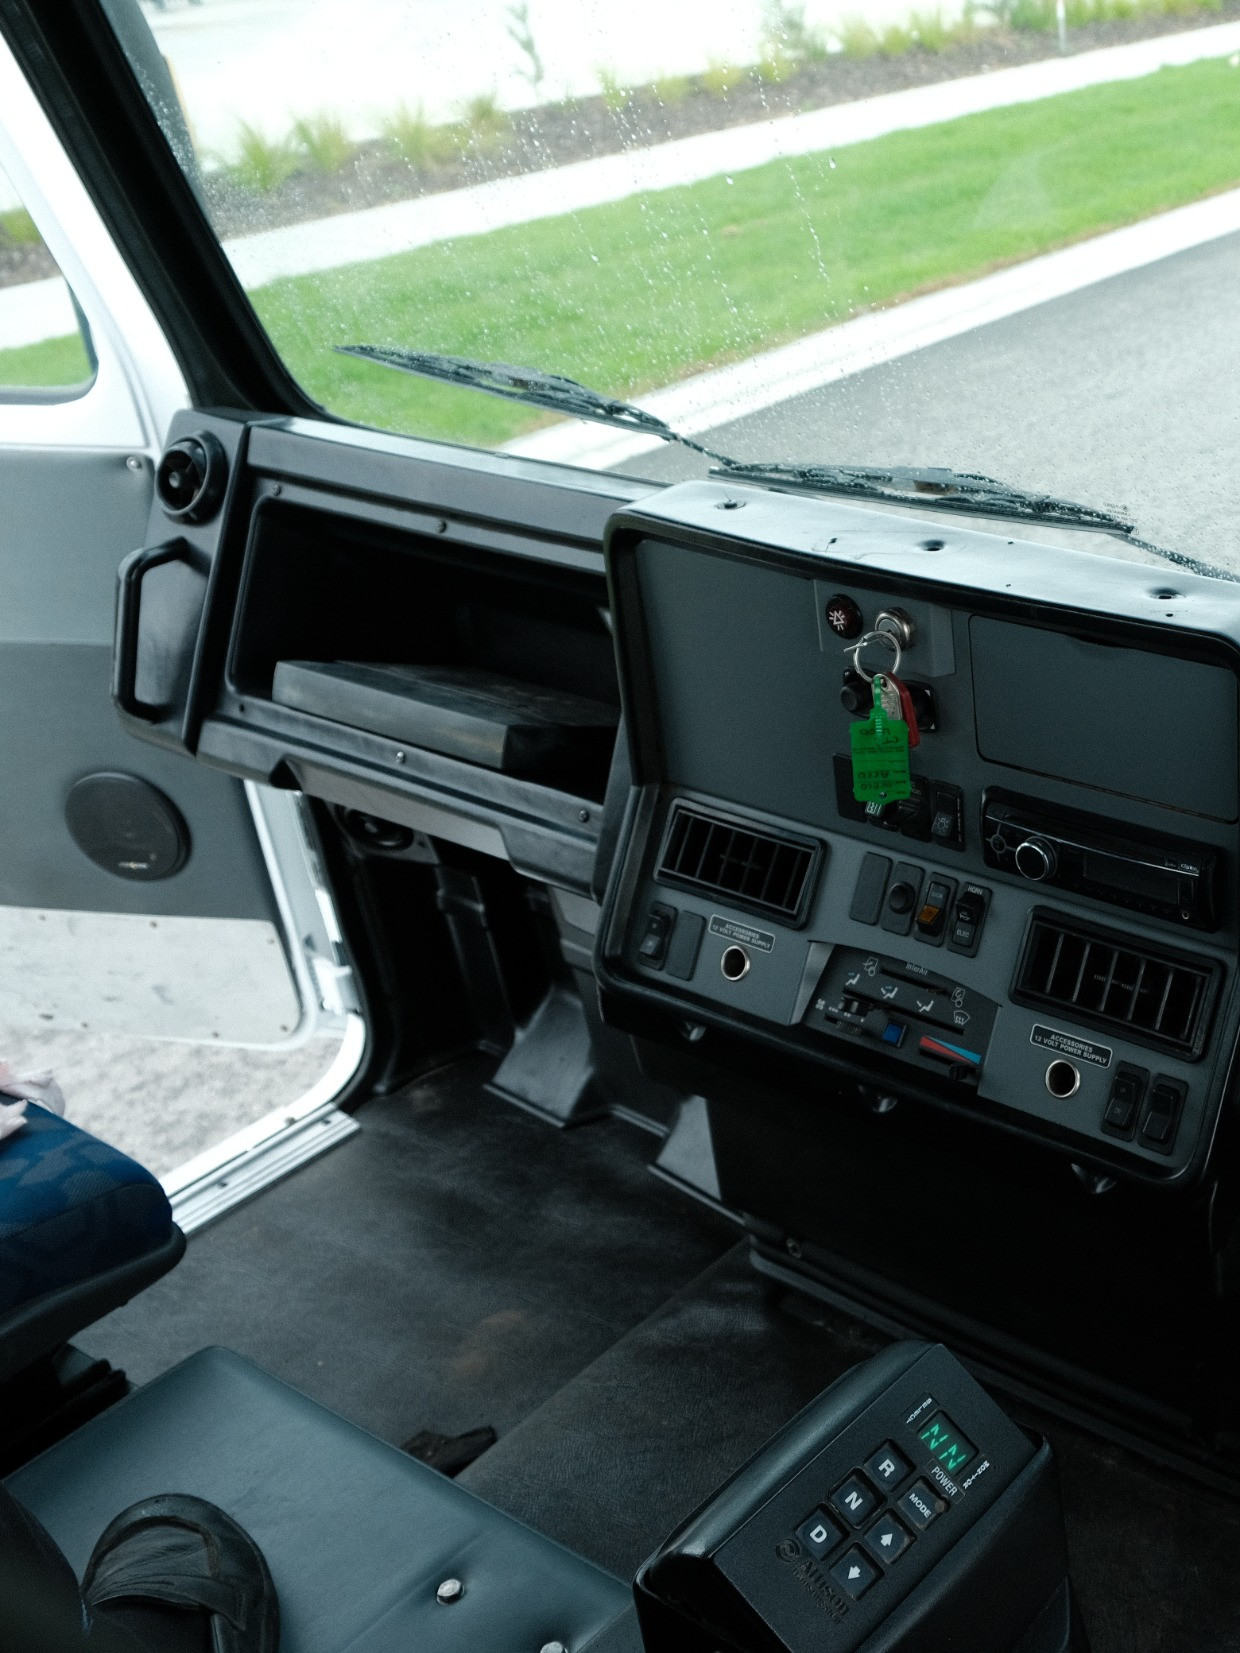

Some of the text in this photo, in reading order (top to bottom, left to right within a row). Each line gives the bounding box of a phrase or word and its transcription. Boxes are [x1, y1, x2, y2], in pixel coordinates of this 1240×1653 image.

[967, 885, 983, 895] HORN
[719, 927, 733, 936] VOLT
[732, 931, 751, 943] POWER
[751, 937, 771, 948] SUPPLY
[725, 923, 760, 940] ACCESSORIES
[1034, 1035, 1107, 1064] 12 VOLT POWER SUPPLY
[1050, 1034, 1093, 1053] ACCESSORIES
[906, 1397, 933, 1424] SELECT
[878, 1458, 895, 1478] R
[963, 1460, 990, 1490] MONITOR
[931, 1465, 958, 1497] POWER
[844, 1490, 863, 1511] N
[909, 1493, 932, 1518] MODE
[809, 1524, 828, 1543] D
